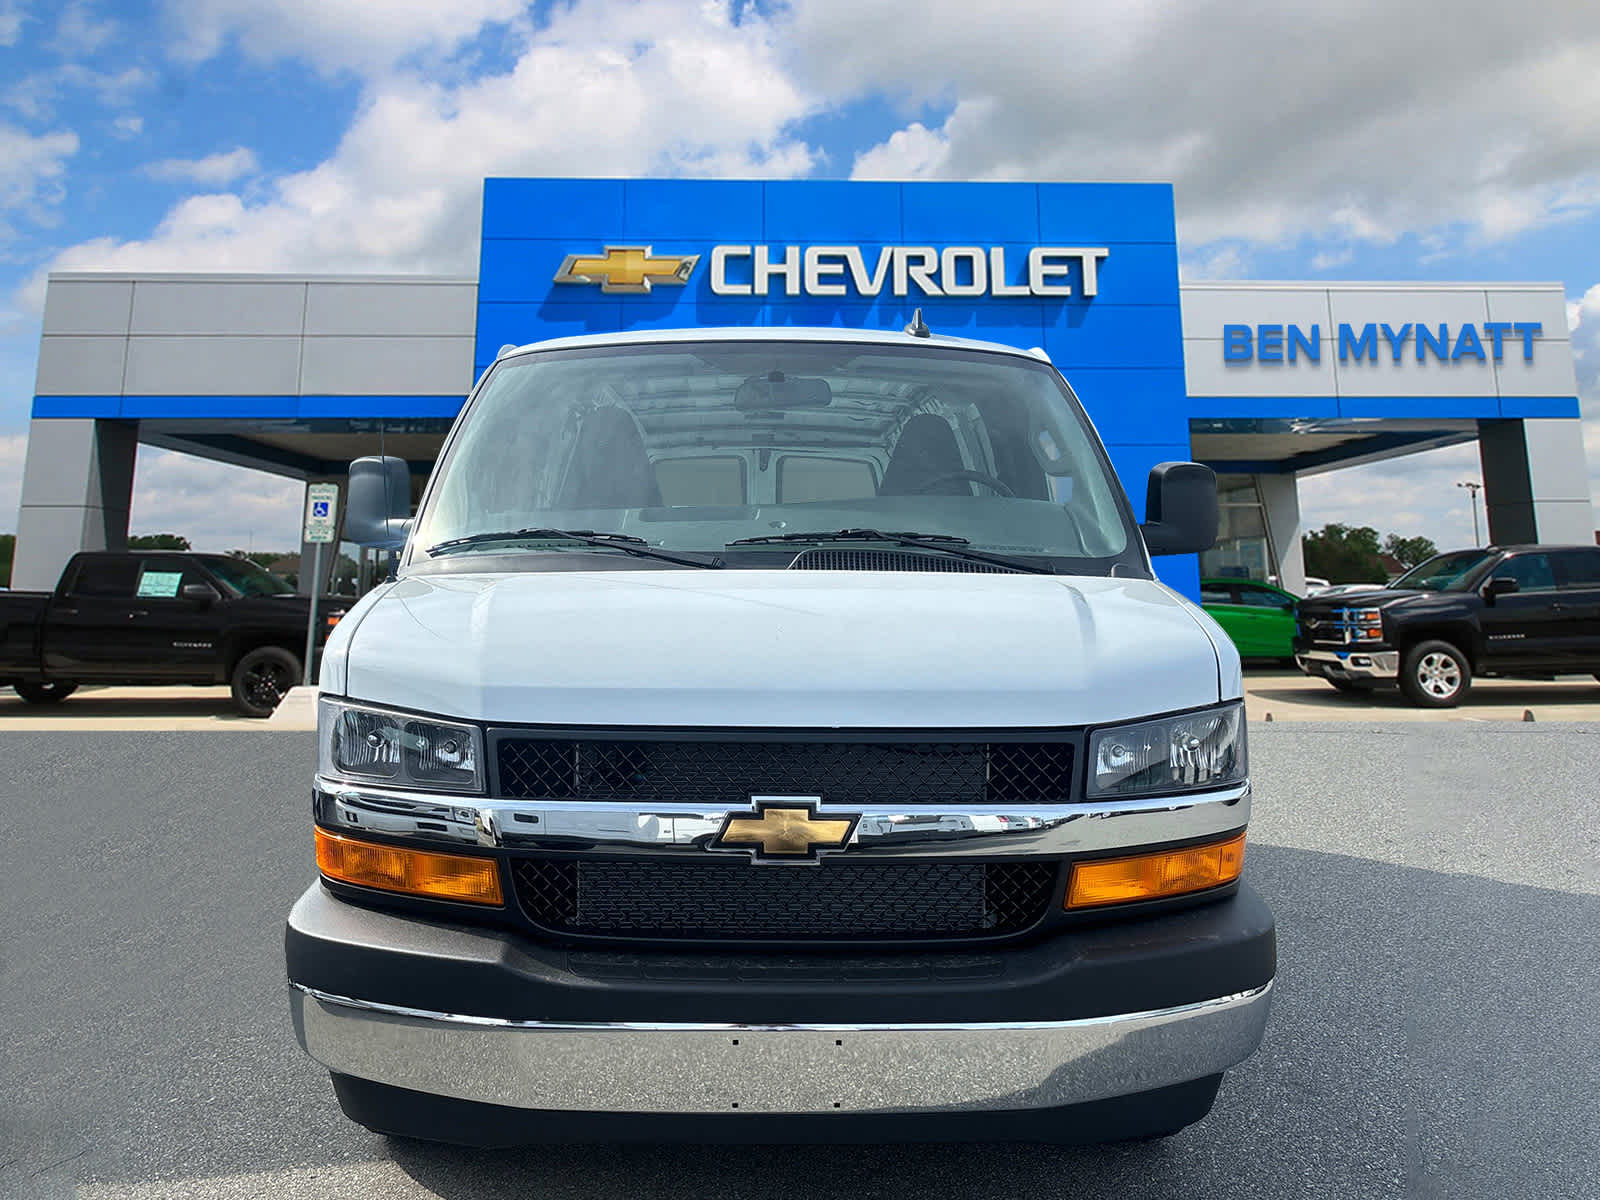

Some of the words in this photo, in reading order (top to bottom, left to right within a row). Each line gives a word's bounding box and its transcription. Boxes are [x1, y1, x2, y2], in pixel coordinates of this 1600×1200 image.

[711, 245, 1110, 297] CHEVROLET
[1223, 323, 1321, 363] BEN
[1338, 321, 1543, 363] MYNATT
